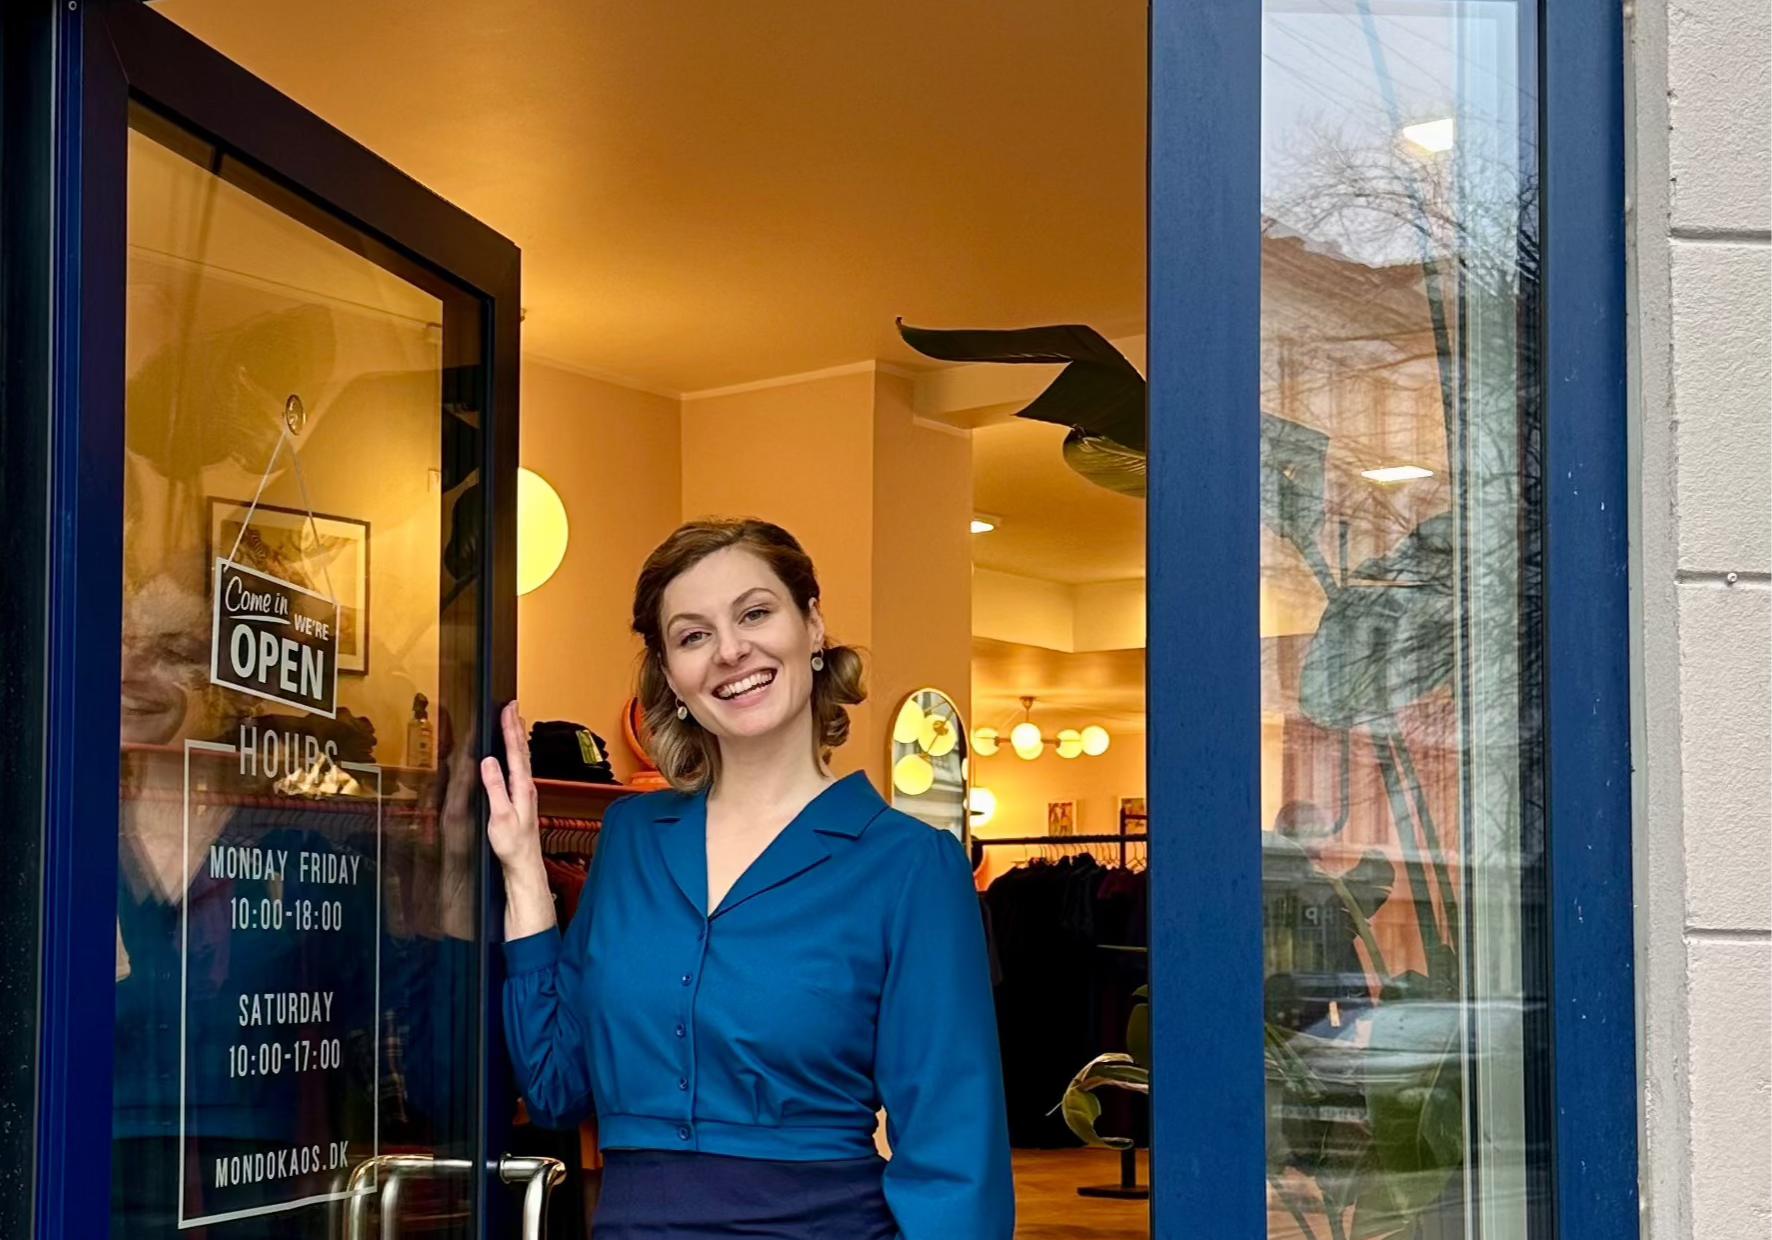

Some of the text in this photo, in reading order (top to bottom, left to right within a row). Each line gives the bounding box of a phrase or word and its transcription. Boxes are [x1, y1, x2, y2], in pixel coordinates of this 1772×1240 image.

[225, 576, 289, 616] Come in
[294, 613, 330, 642] WE'RE
[230, 623, 324, 701] OPEN
[210, 845, 360, 886] MONDAY FRIDAY
[230, 896, 342, 932] 10:00-18:00
[238, 991, 334, 1027] SATURDAY
[229, 1038, 341, 1079] 10:00-17:00
[215, 1140, 349, 1189] MONDOKAOS.DK
